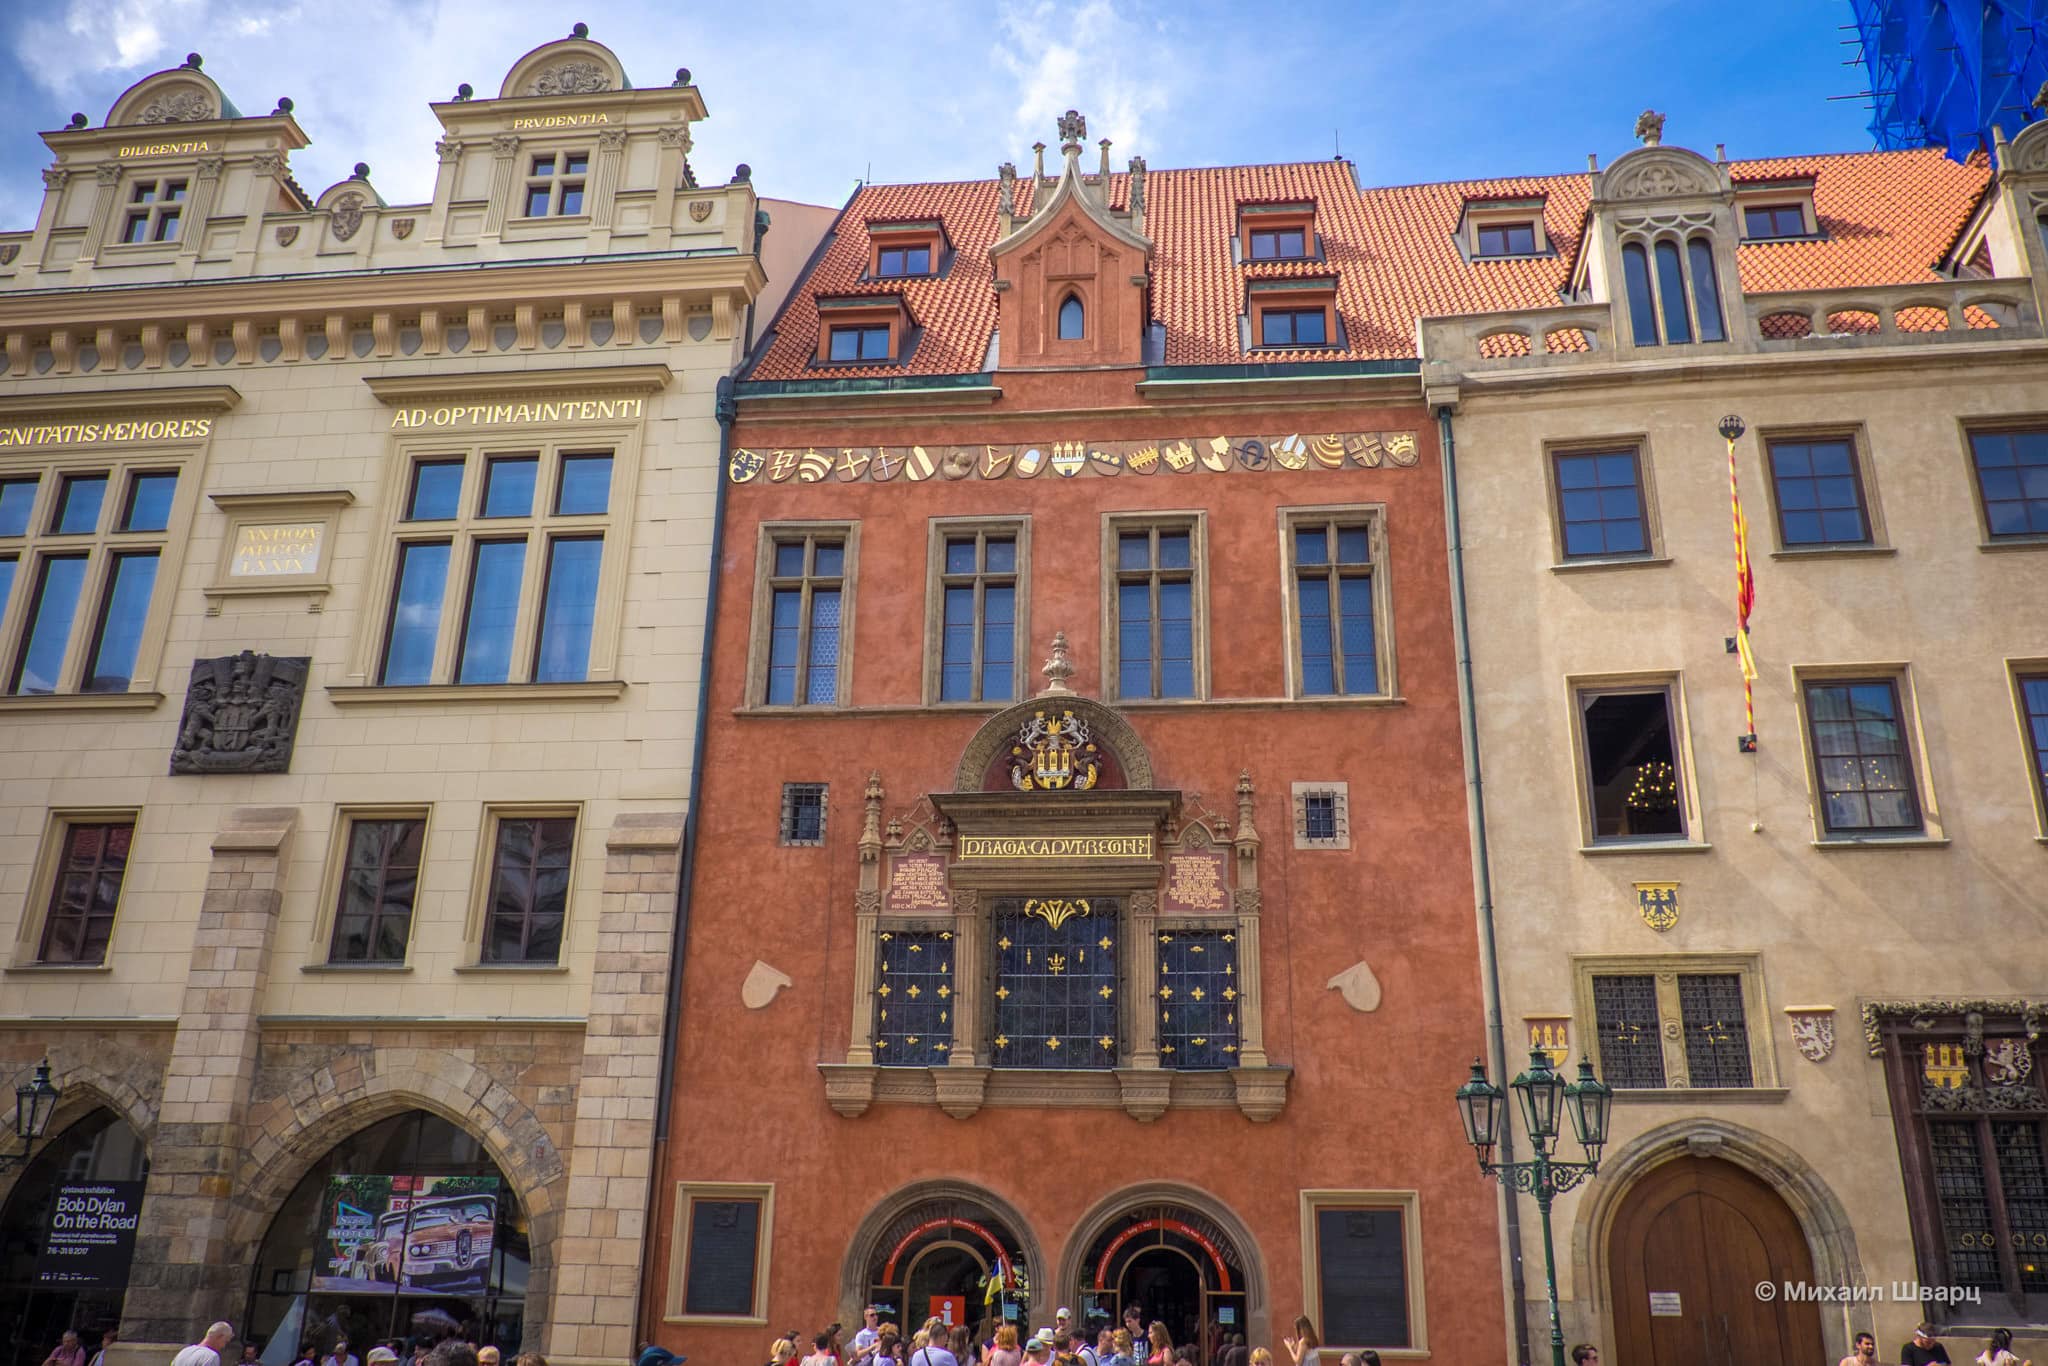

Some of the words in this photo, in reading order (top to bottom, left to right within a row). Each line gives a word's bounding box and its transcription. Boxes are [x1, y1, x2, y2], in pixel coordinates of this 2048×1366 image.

[514, 113, 609, 129] PRVDENTIA
[120, 141, 209, 157] DILIGENTIA
[57, 1197, 86, 1212] Bob
[87, 1198, 126, 1215] Dylan
[53, 1213, 74, 1228] On
[76, 1214, 98, 1229] the
[100, 1214, 138, 1229] Road
